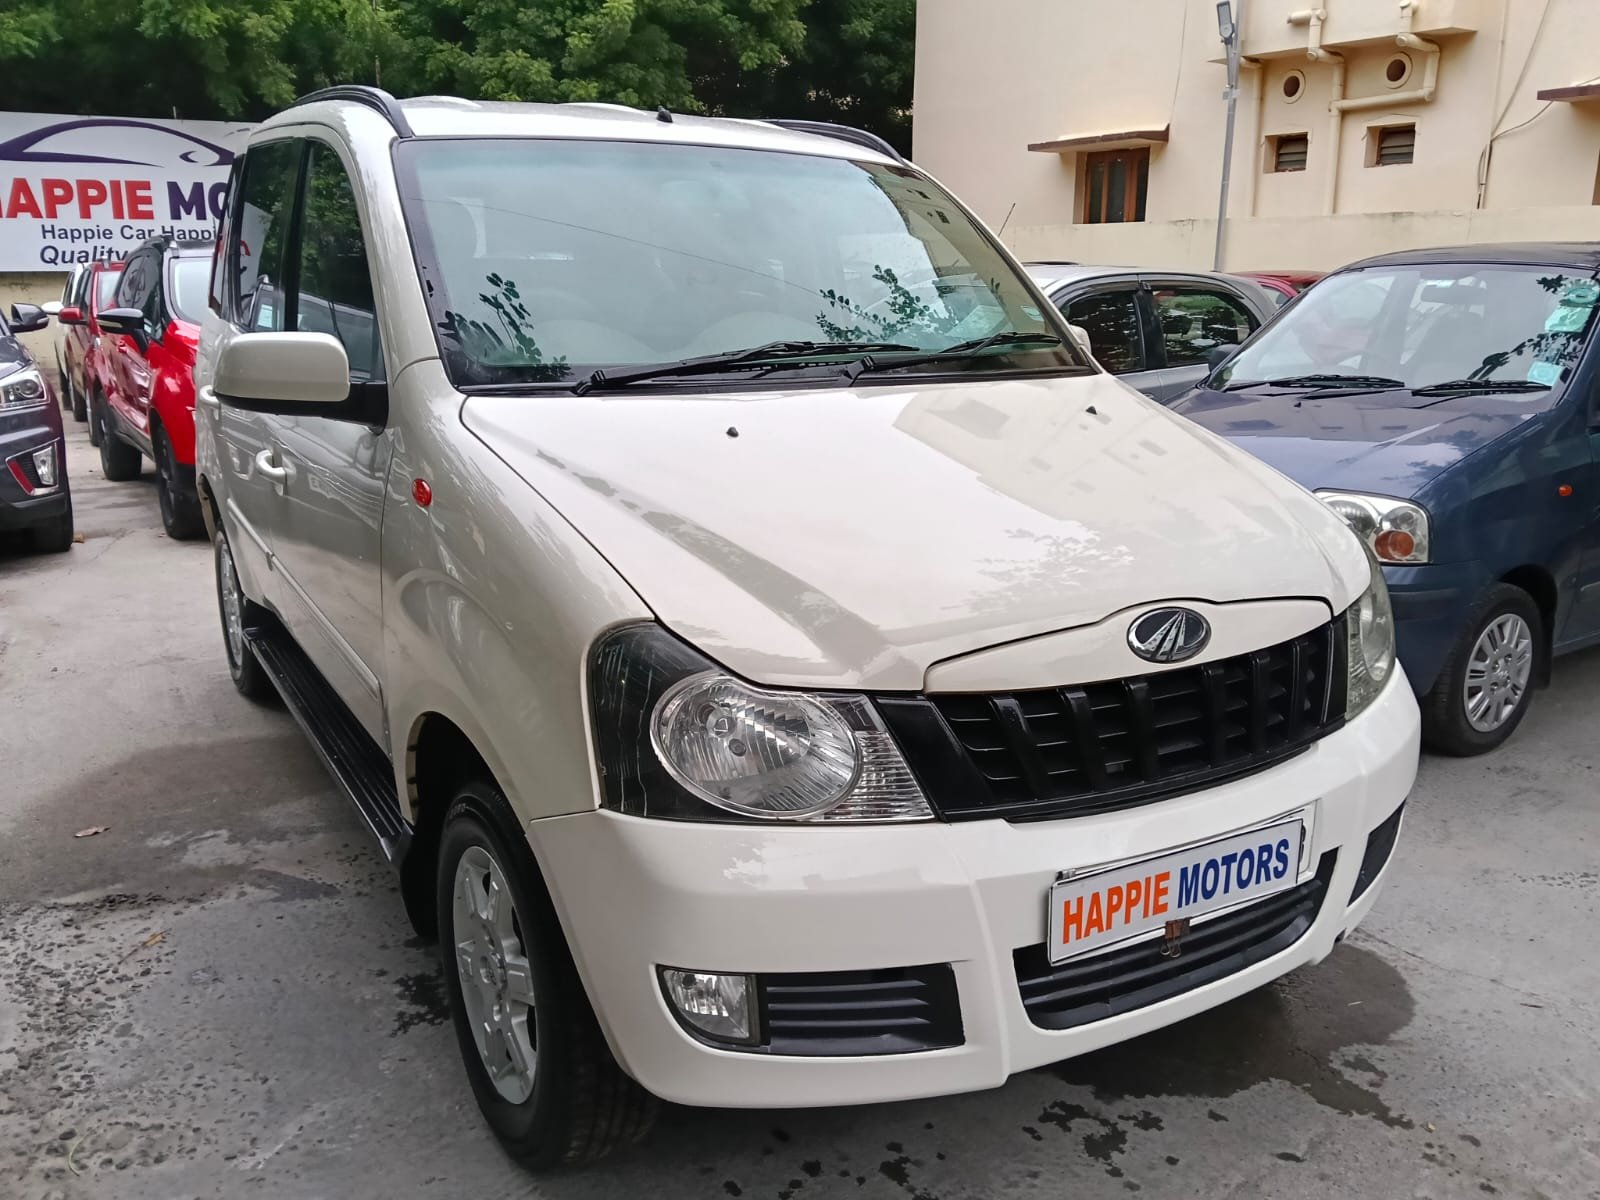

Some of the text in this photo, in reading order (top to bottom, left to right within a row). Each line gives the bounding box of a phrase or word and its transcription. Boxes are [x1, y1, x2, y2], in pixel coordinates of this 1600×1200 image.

[0, 177, 154, 220] APPIE
[41, 224, 113, 243] Happie
[120, 224, 155, 240] Car
[40, 245, 129, 266] Quality
[1062, 838, 1290, 944] HAPPIE MOTORS
